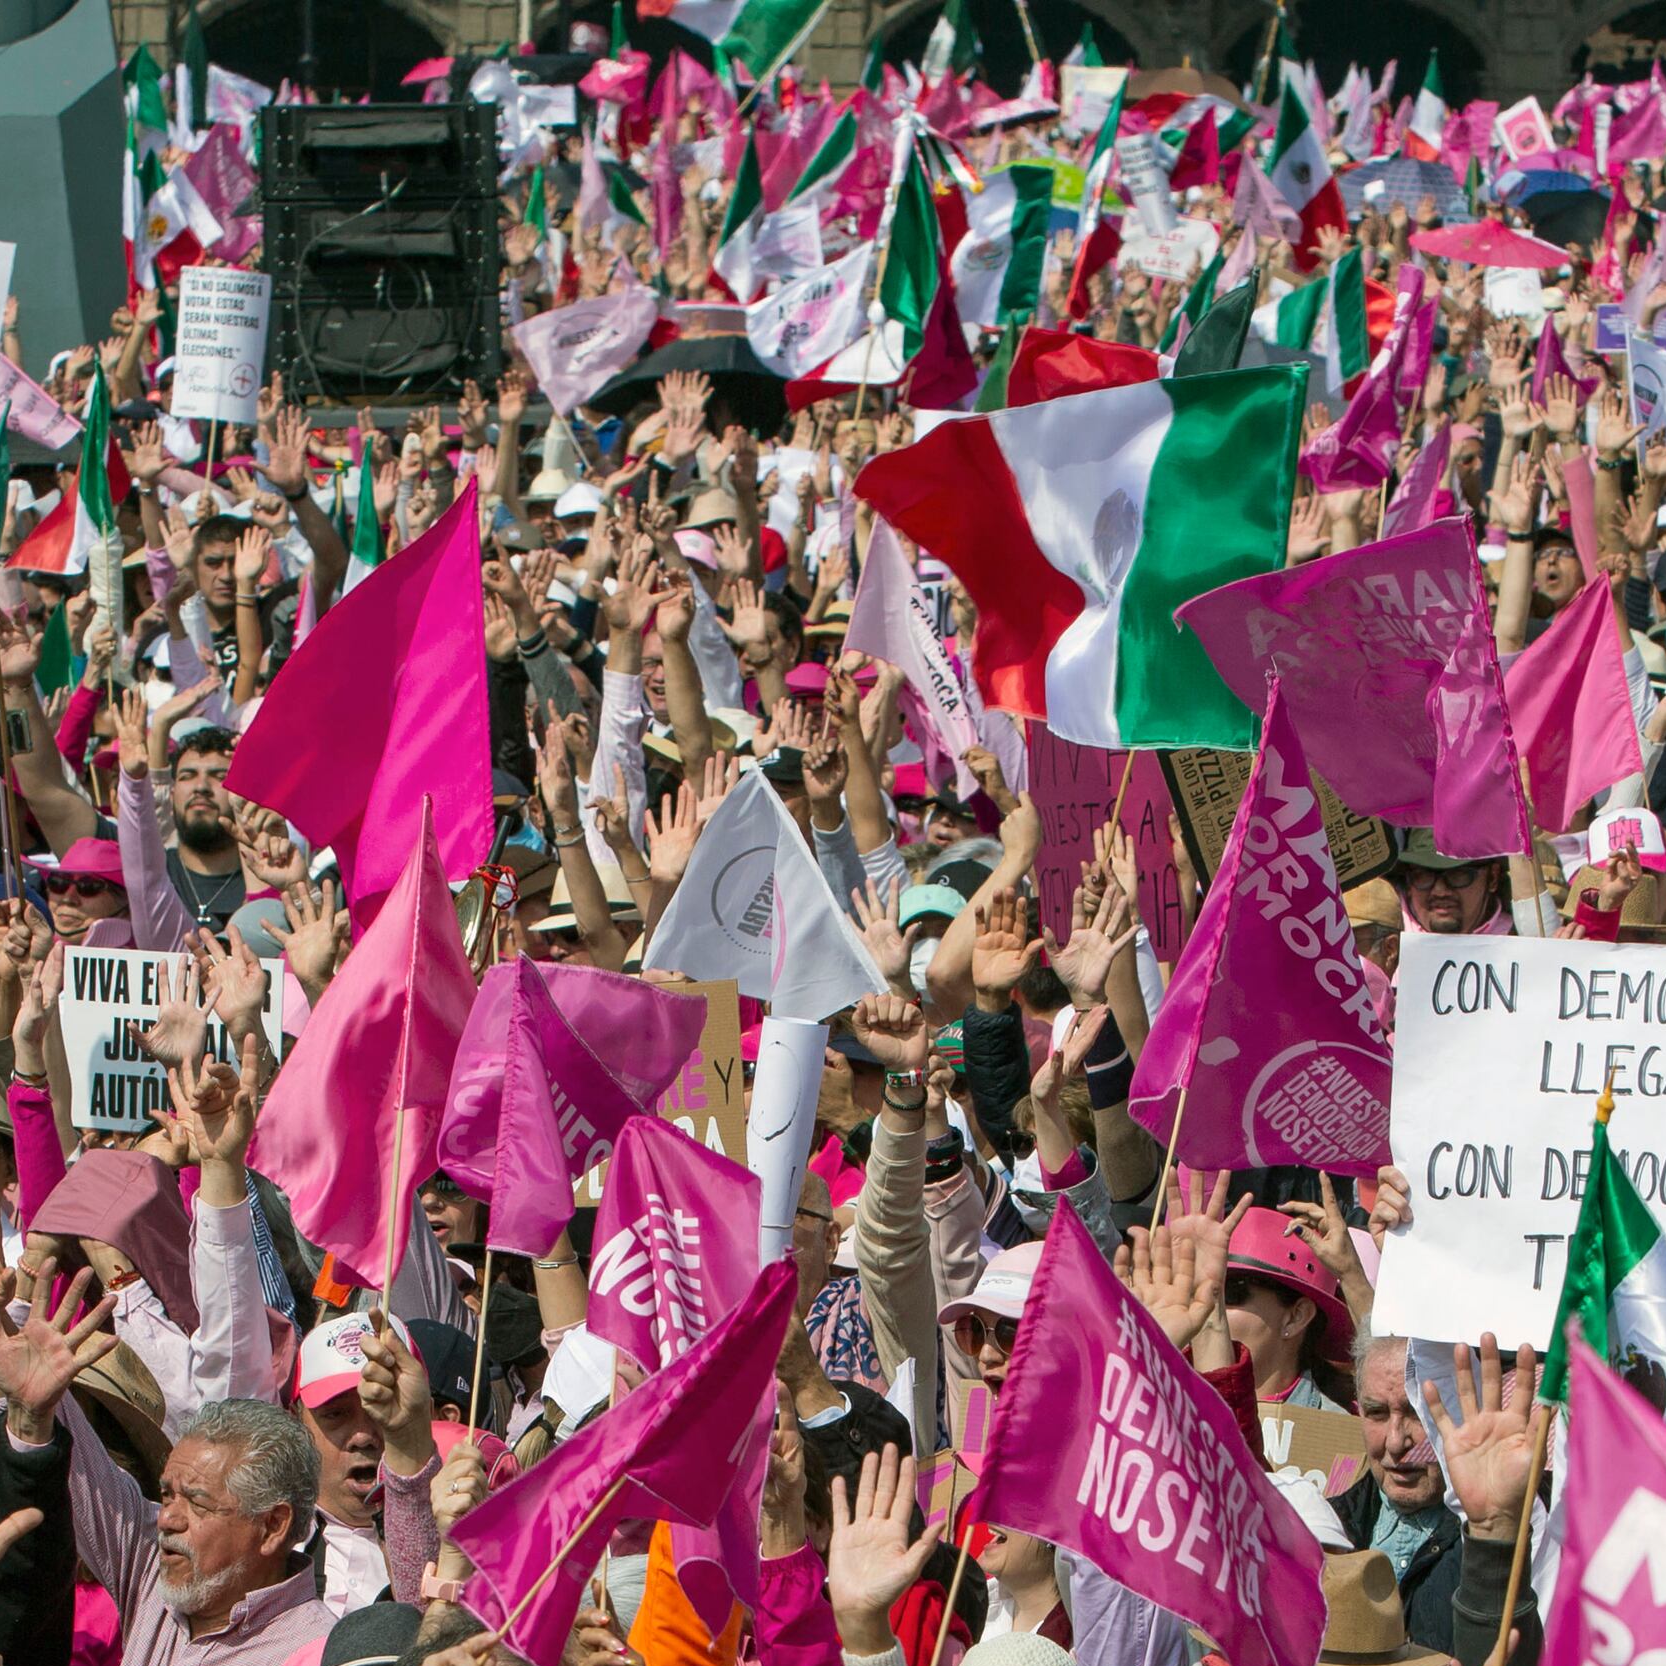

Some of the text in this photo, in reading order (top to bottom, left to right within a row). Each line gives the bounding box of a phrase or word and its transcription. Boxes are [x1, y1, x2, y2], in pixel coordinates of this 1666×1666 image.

[202, 281, 213, 291] NO
[216, 281, 255, 296] SALIMOS
[213, 314, 260, 329] NUESTRAS
[73, 957, 130, 1004] VIVA
[1433, 959, 1519, 1015] CON
[104, 1017, 231, 1066] JUDAL
[1427, 1141, 1514, 1200] CON
